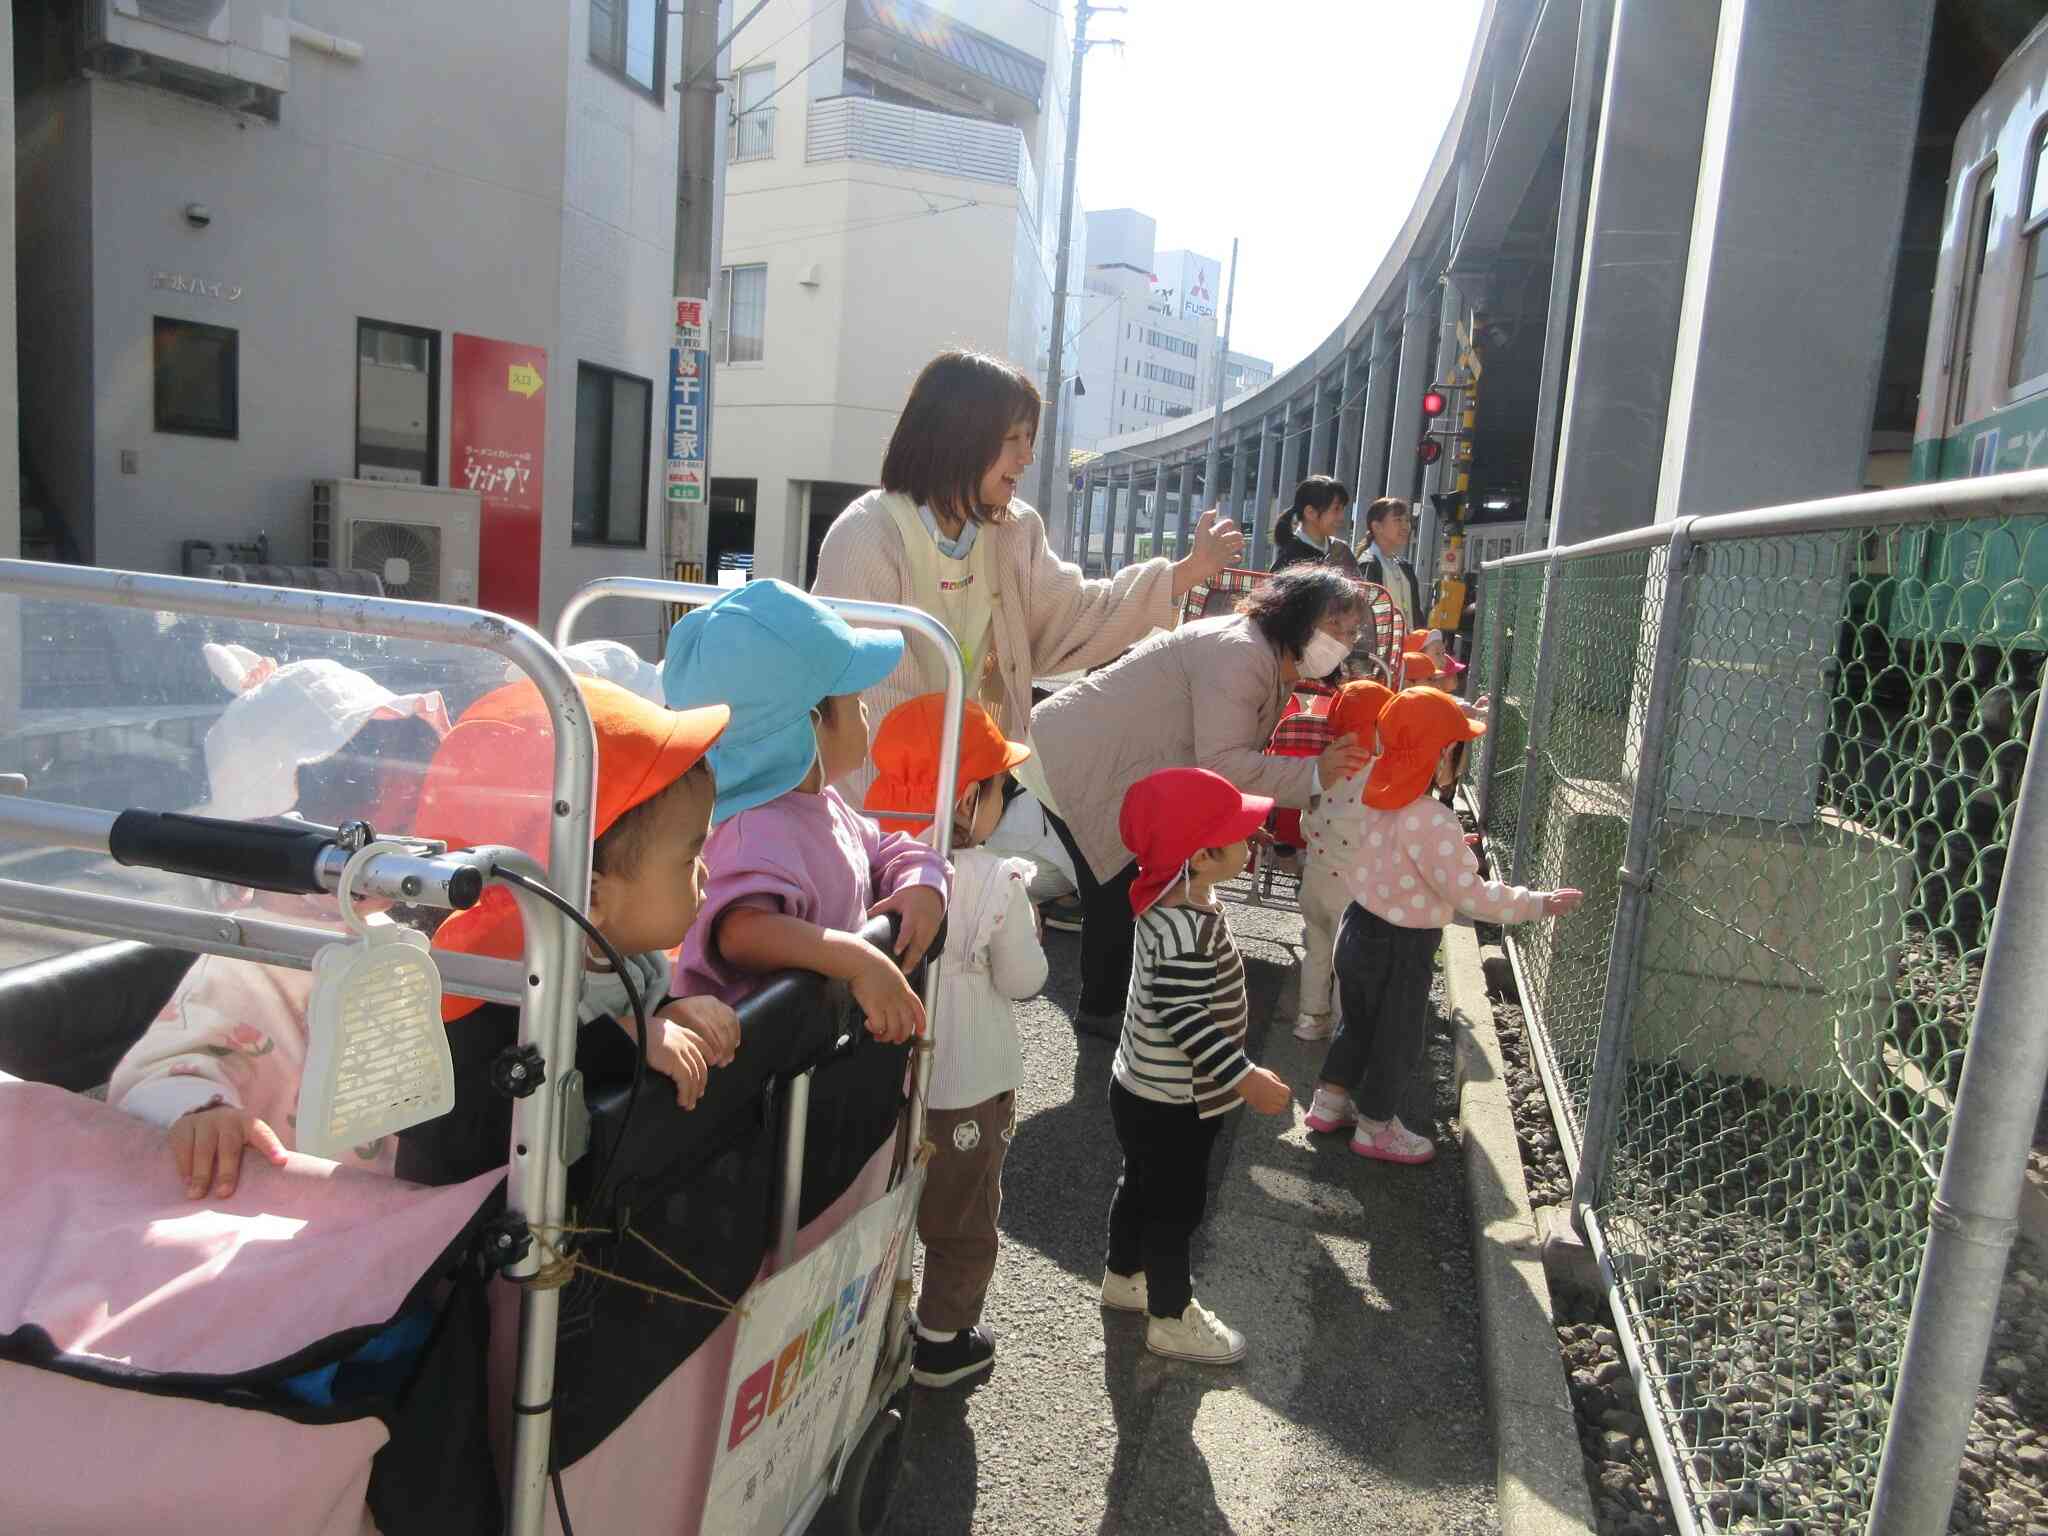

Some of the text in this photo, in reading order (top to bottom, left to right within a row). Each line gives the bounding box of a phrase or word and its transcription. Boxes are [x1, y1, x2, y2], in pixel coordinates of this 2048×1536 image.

[676, 301, 702, 327] 質
[512, 372, 532, 386] 入口
[672, 377, 701, 459] 千日家
